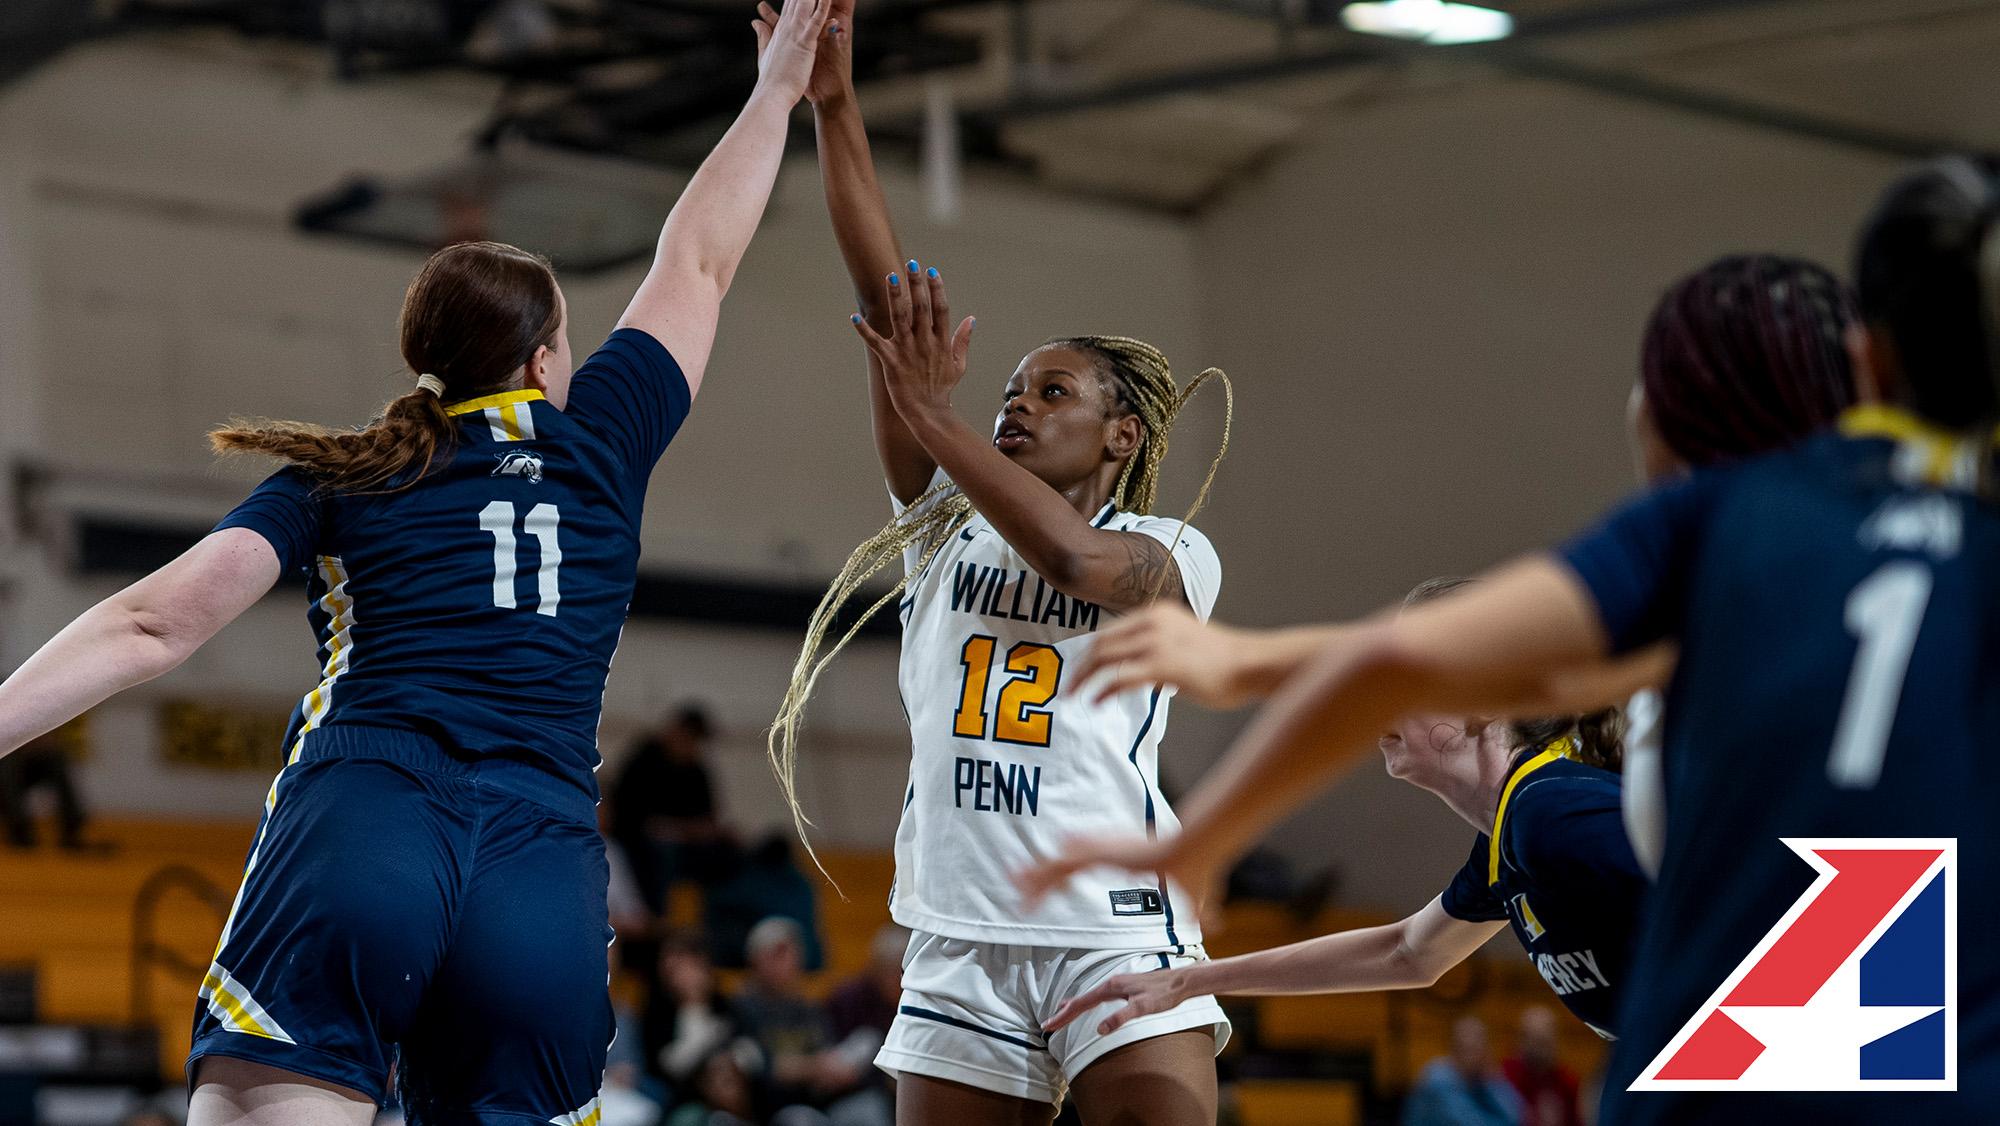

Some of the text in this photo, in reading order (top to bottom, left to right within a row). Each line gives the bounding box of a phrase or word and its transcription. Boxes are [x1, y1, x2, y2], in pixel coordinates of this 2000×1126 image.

[478, 500, 562, 618] 11
[951, 560, 1101, 632] WILLIAM
[952, 633, 1063, 748] 12
[1825, 560, 1934, 789] 1
[954, 757, 1041, 817] PENN
[1147, 895, 1156, 907] L
